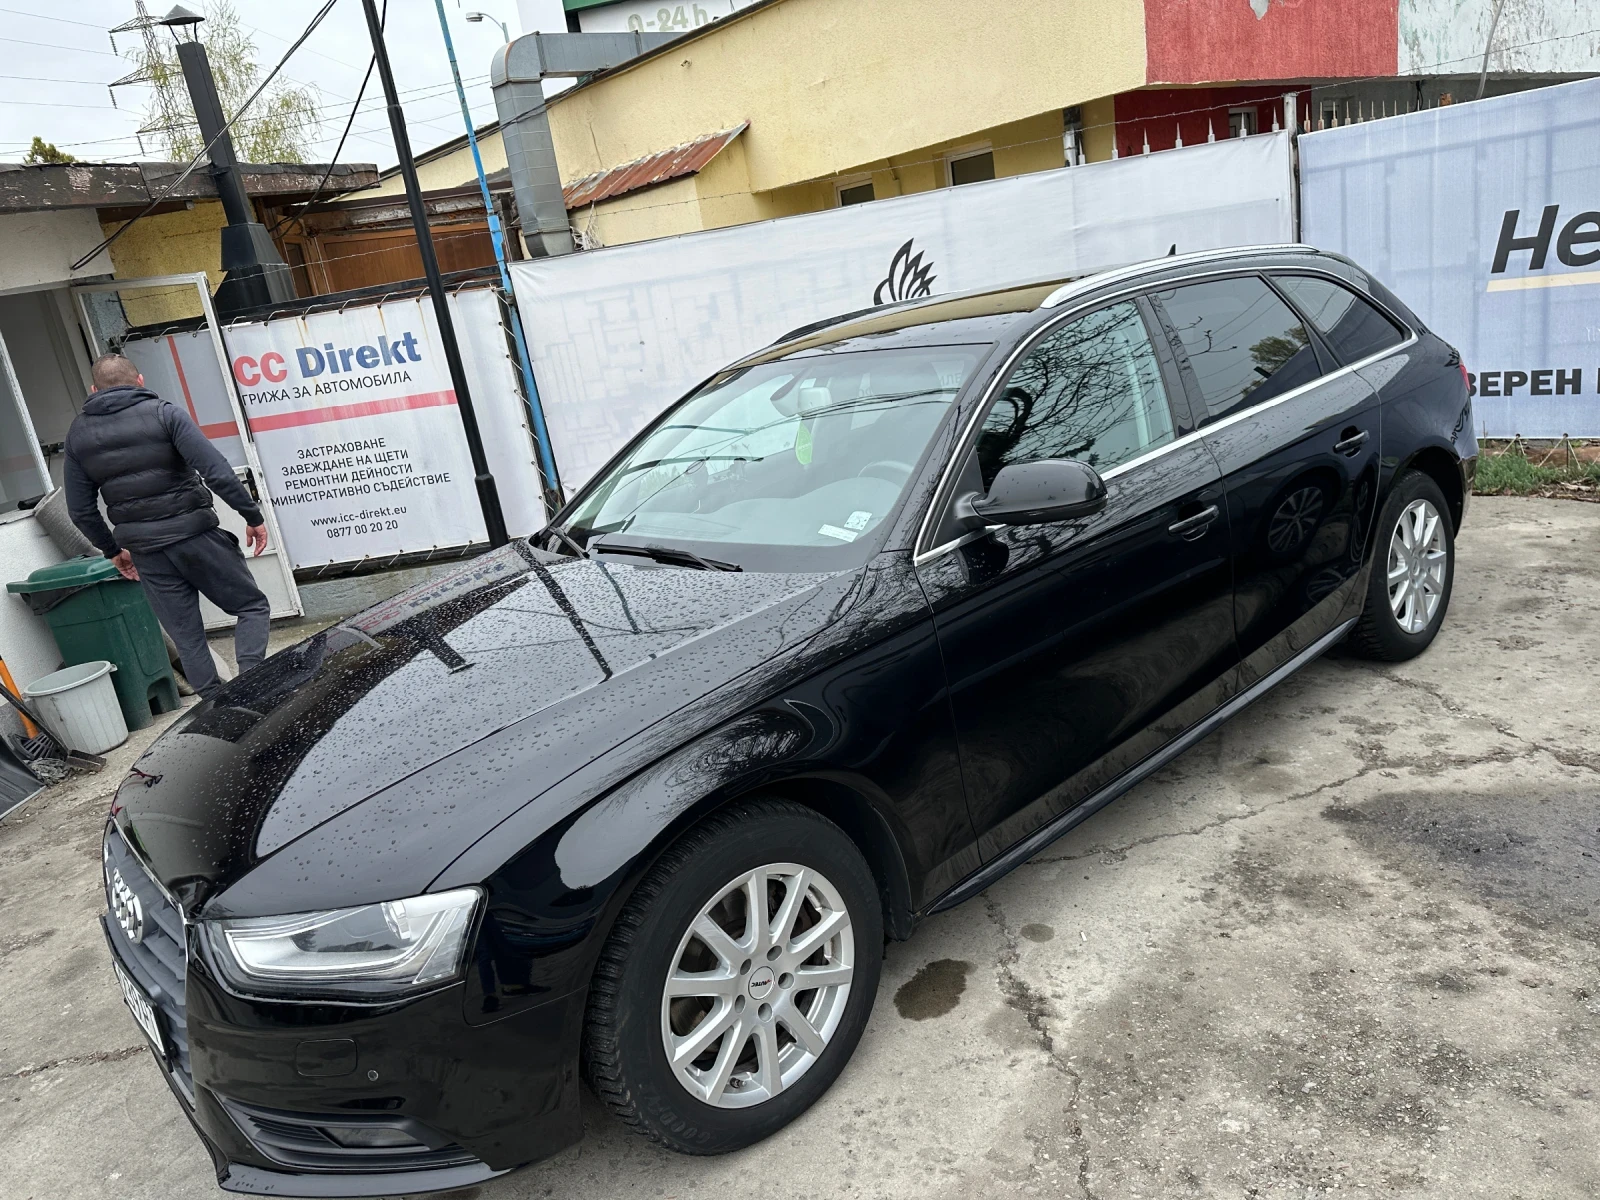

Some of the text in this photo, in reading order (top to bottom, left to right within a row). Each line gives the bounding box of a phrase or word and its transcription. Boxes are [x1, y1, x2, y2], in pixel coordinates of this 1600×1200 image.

[295, 331, 422, 379] Direkt
[241, 370, 412, 406] ГРИЖА ЗА АВТОМОБИЛА
[297, 437, 386, 459] ЗАСТРАХОВАНЕ
[281, 449, 409, 476] ЗАВЕЖДАНЕ НА ЩЕТИ
[285, 463, 413, 490] РЕМОНТНИ ДЕЙНОСТИ
[373, 472, 451, 492] СЪДЕЙСТВИЕ
[310, 506, 407, 527] www.icc-direkt.eu
[326, 519, 399, 539] 0877 00 20 20
